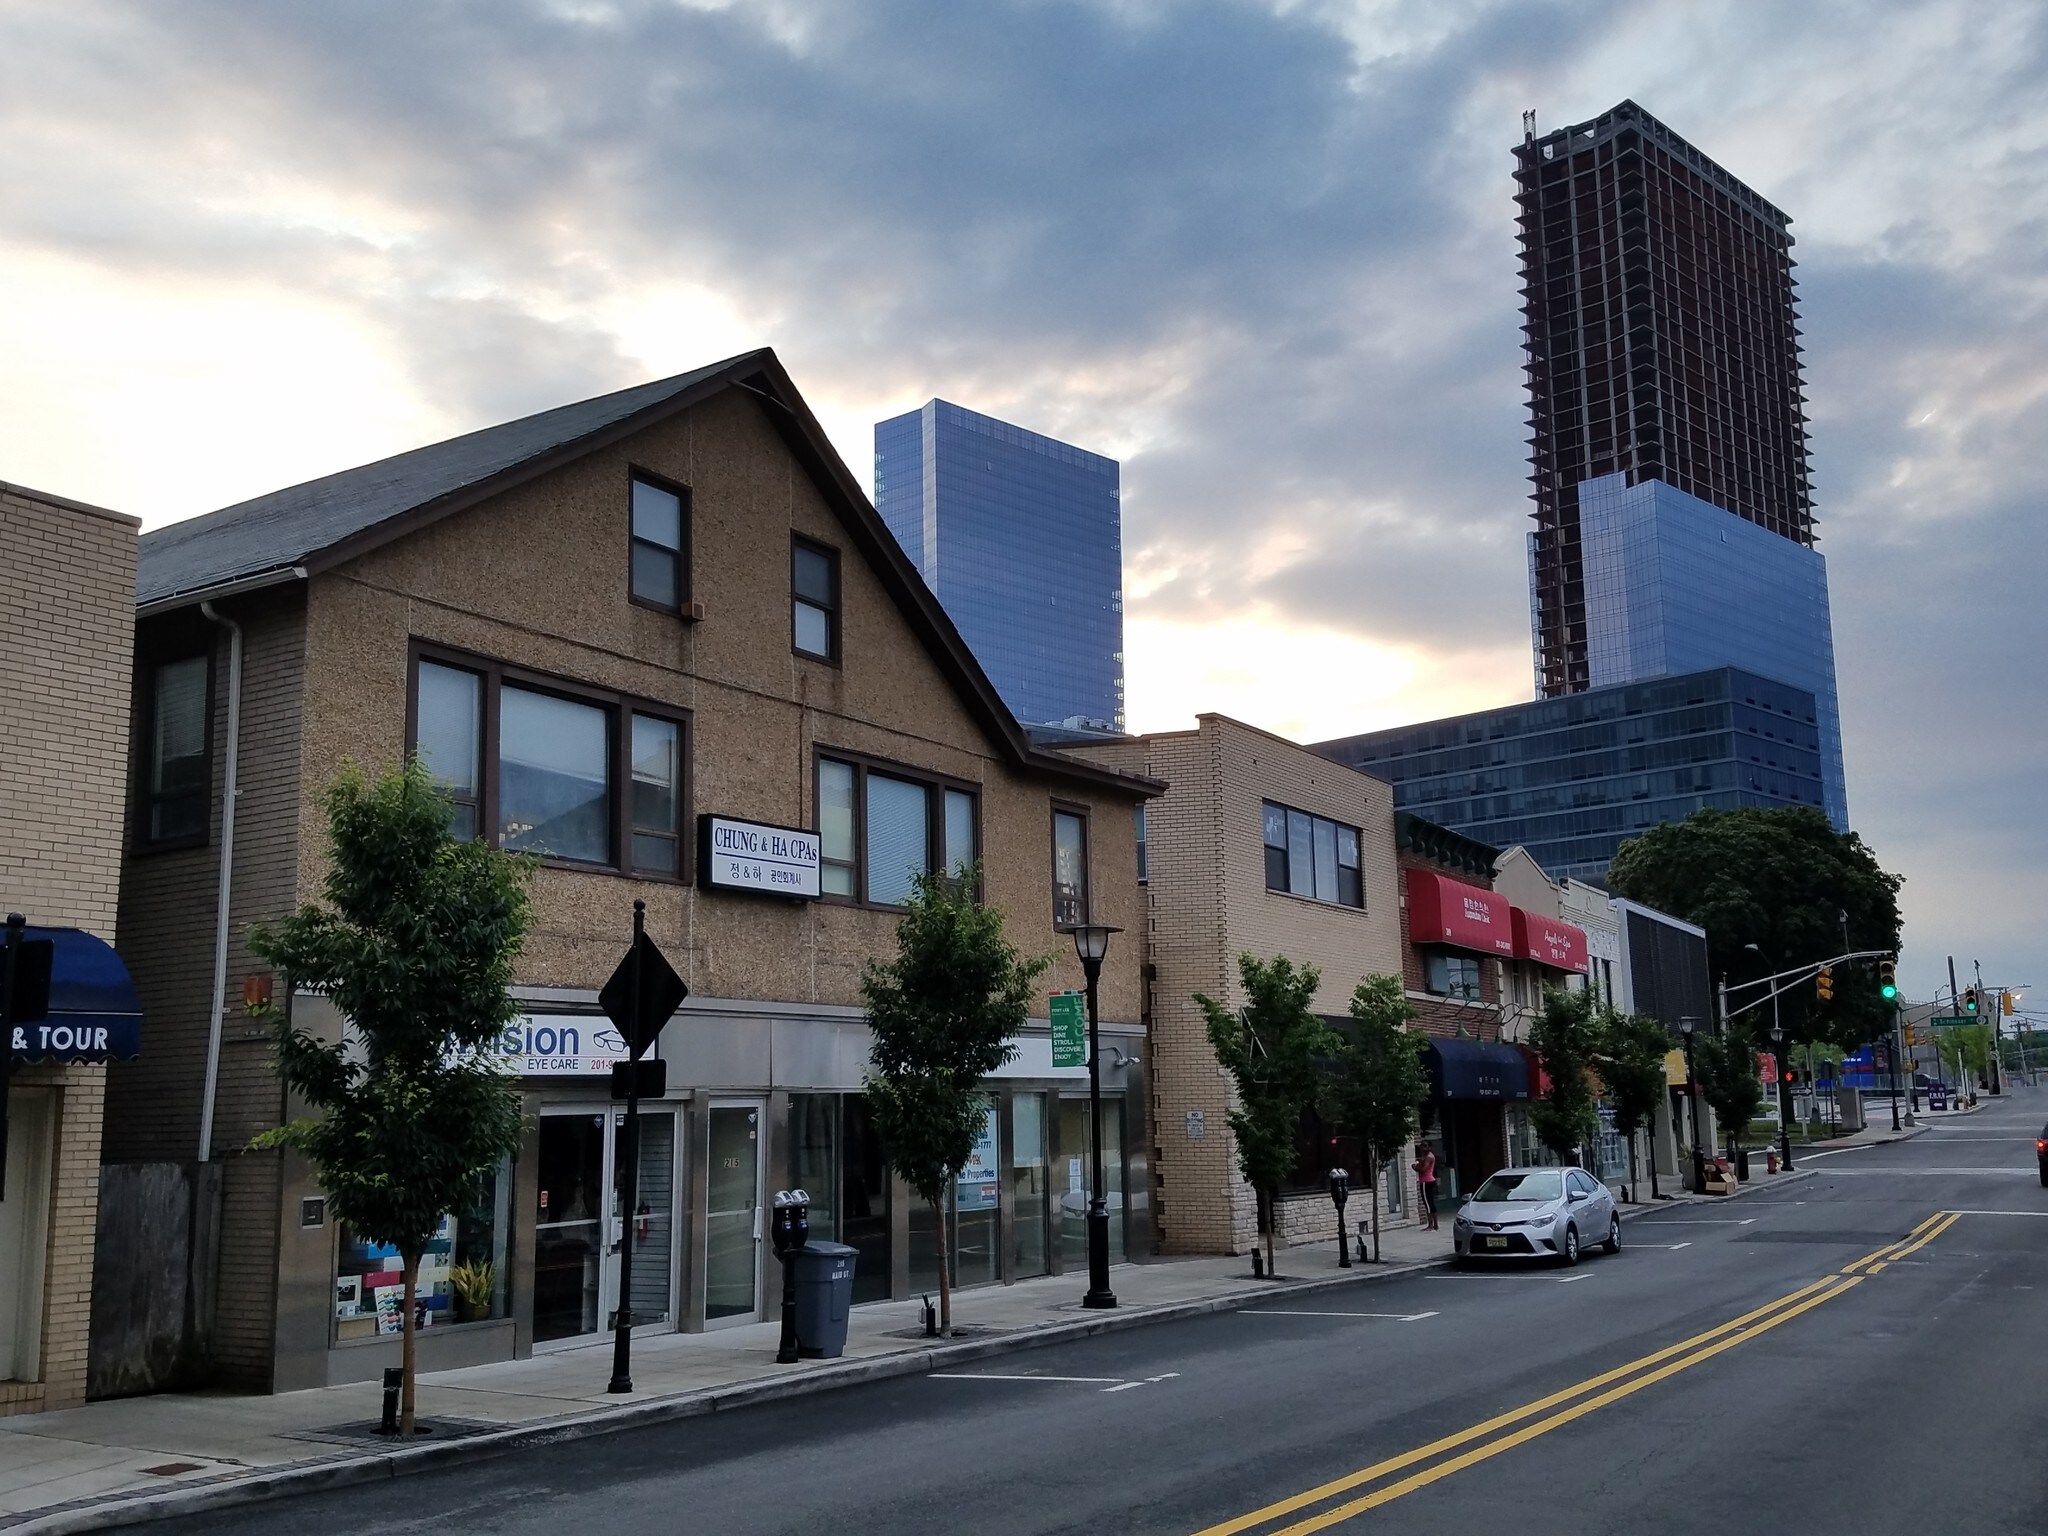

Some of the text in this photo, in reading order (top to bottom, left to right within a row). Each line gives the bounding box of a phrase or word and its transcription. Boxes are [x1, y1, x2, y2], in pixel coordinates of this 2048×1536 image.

[715, 827, 817, 861] CHUNG & HA CPAs
[731, 863, 740, 879] 정
[743, 866, 751, 879] &
[752, 866, 762, 882] 하
[12, 1026, 108, 1050] & TOUR
[528, 1058, 548, 1070] EYE
[550, 1058, 579, 1070] CARE
[724, 1157, 740, 1169] 215
[967, 1168, 995, 1181] Properties
